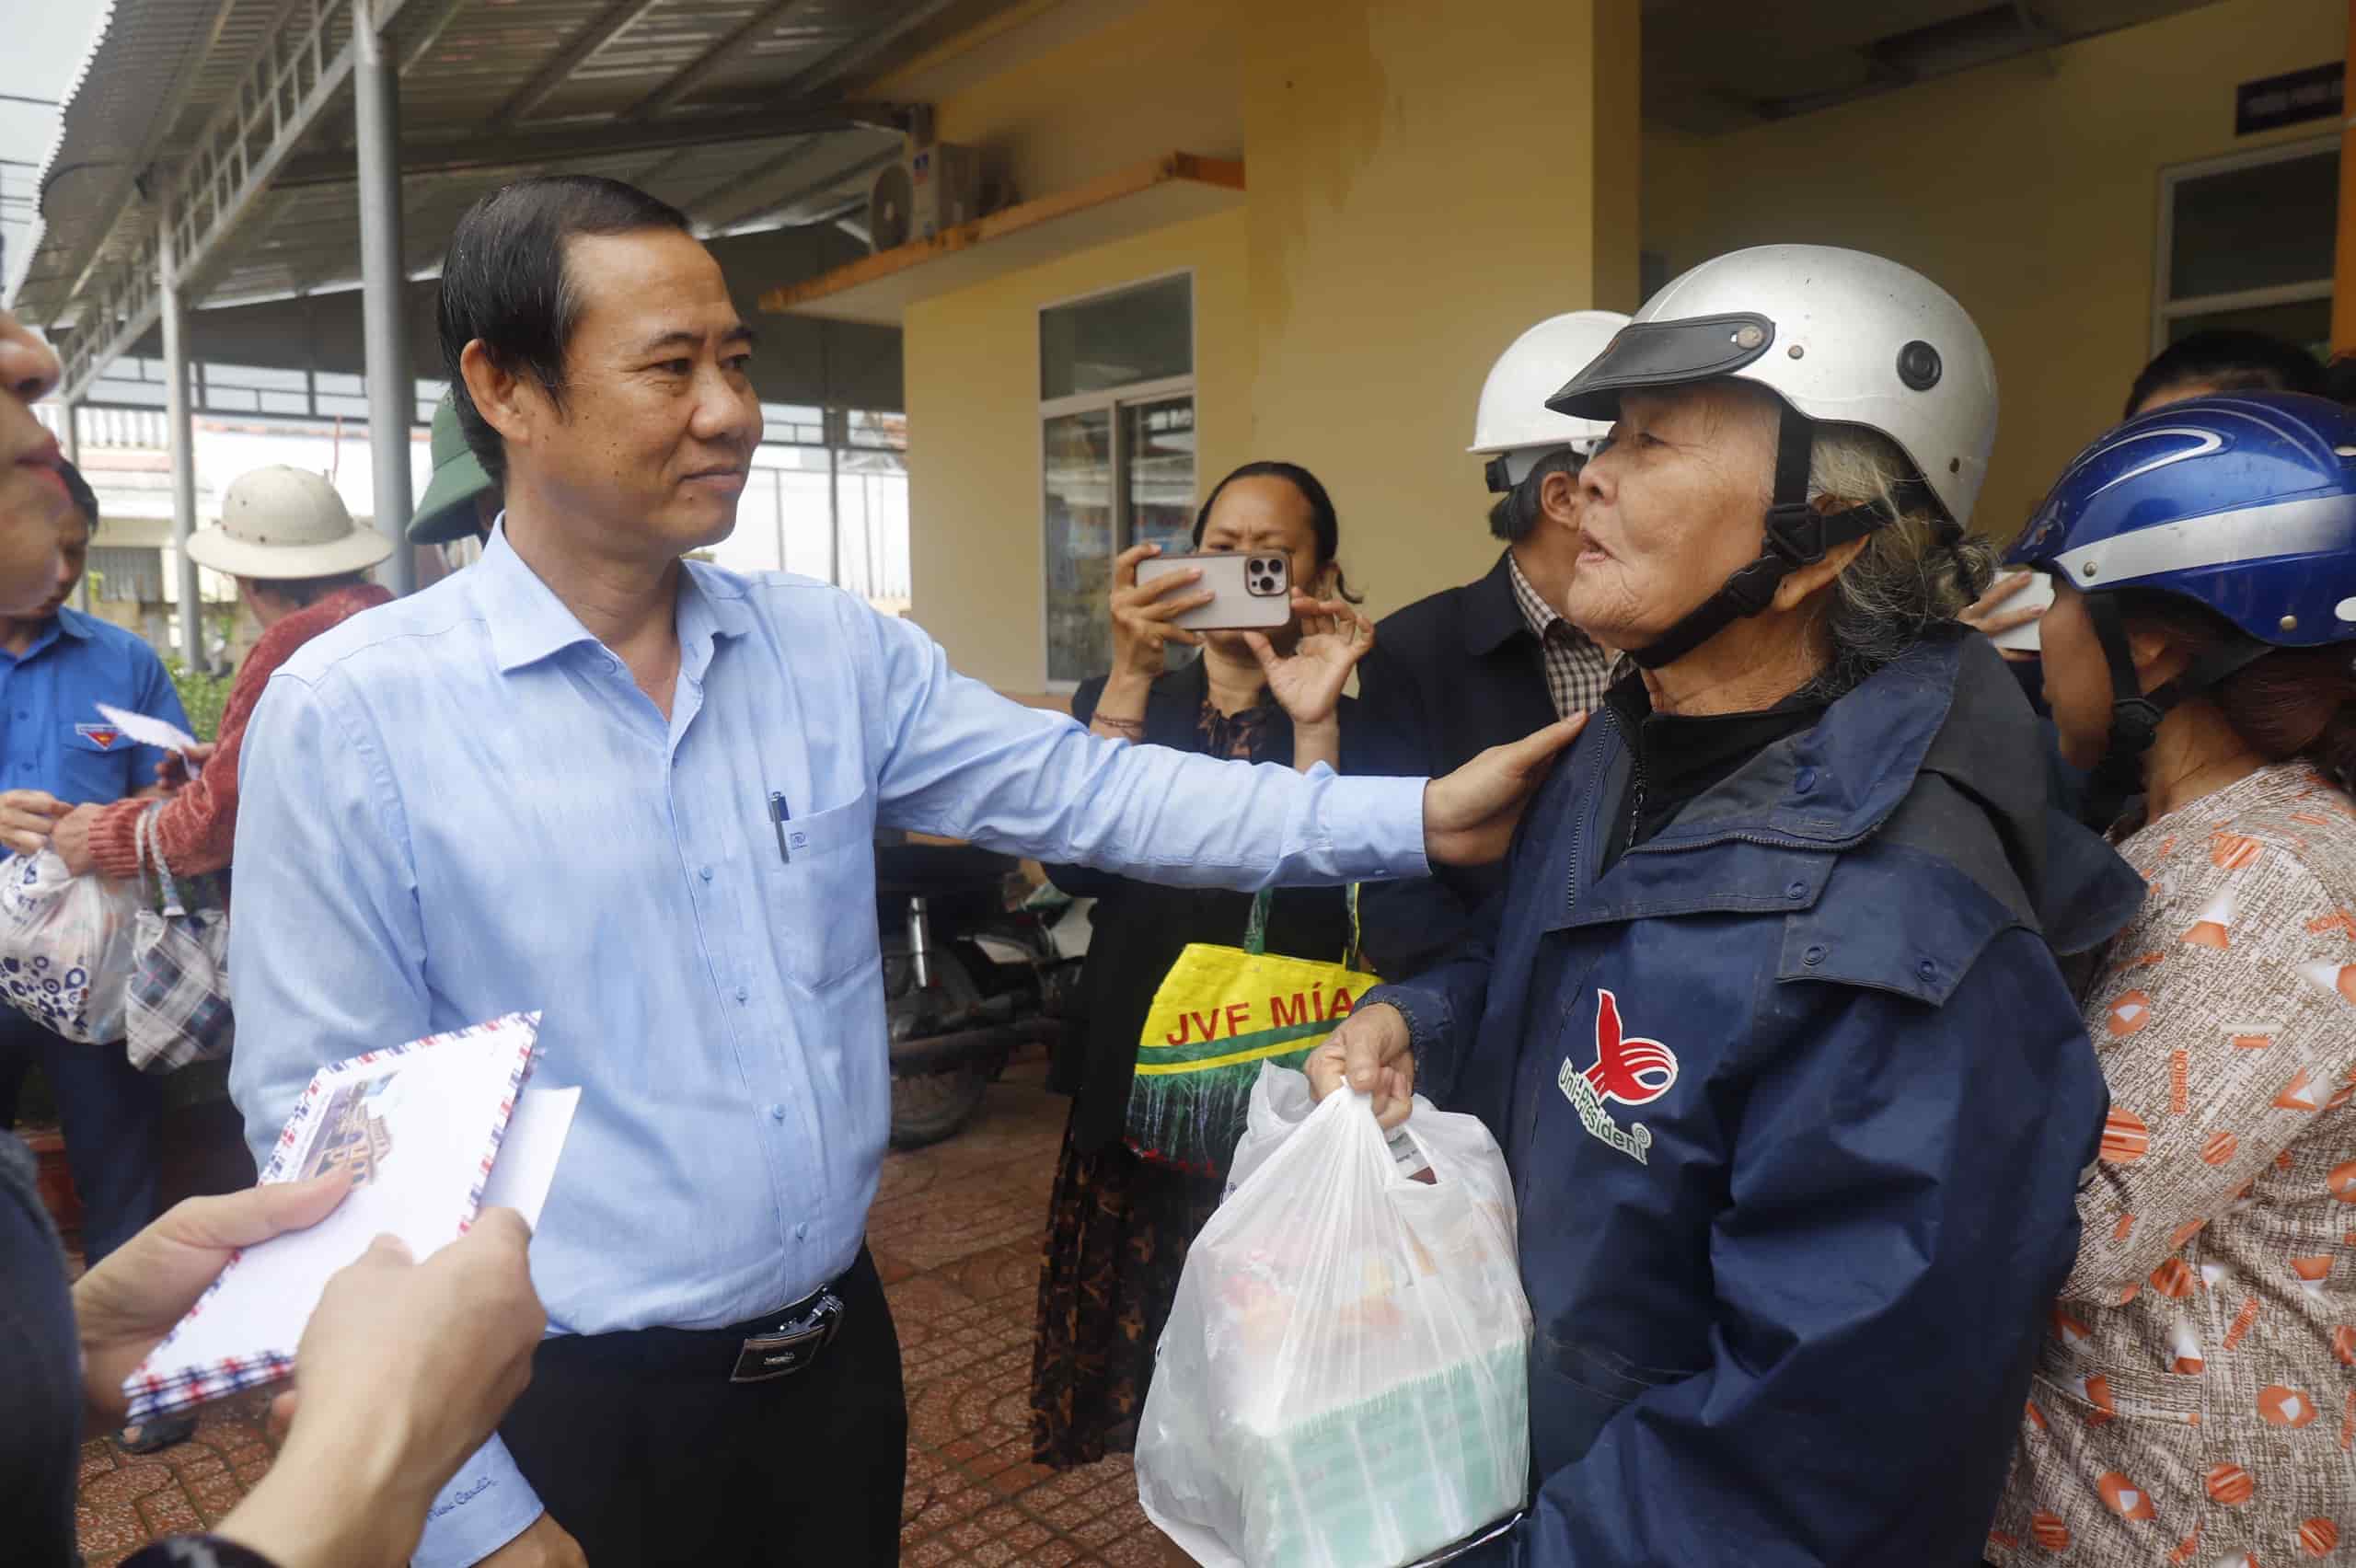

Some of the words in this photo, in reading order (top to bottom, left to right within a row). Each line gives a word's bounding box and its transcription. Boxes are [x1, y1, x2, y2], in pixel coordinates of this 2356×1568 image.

[1166, 1001, 1252, 1047] JVF
[1269, 981, 1356, 1030] MÍA
[2173, 1050, 2189, 1113] FASHION
